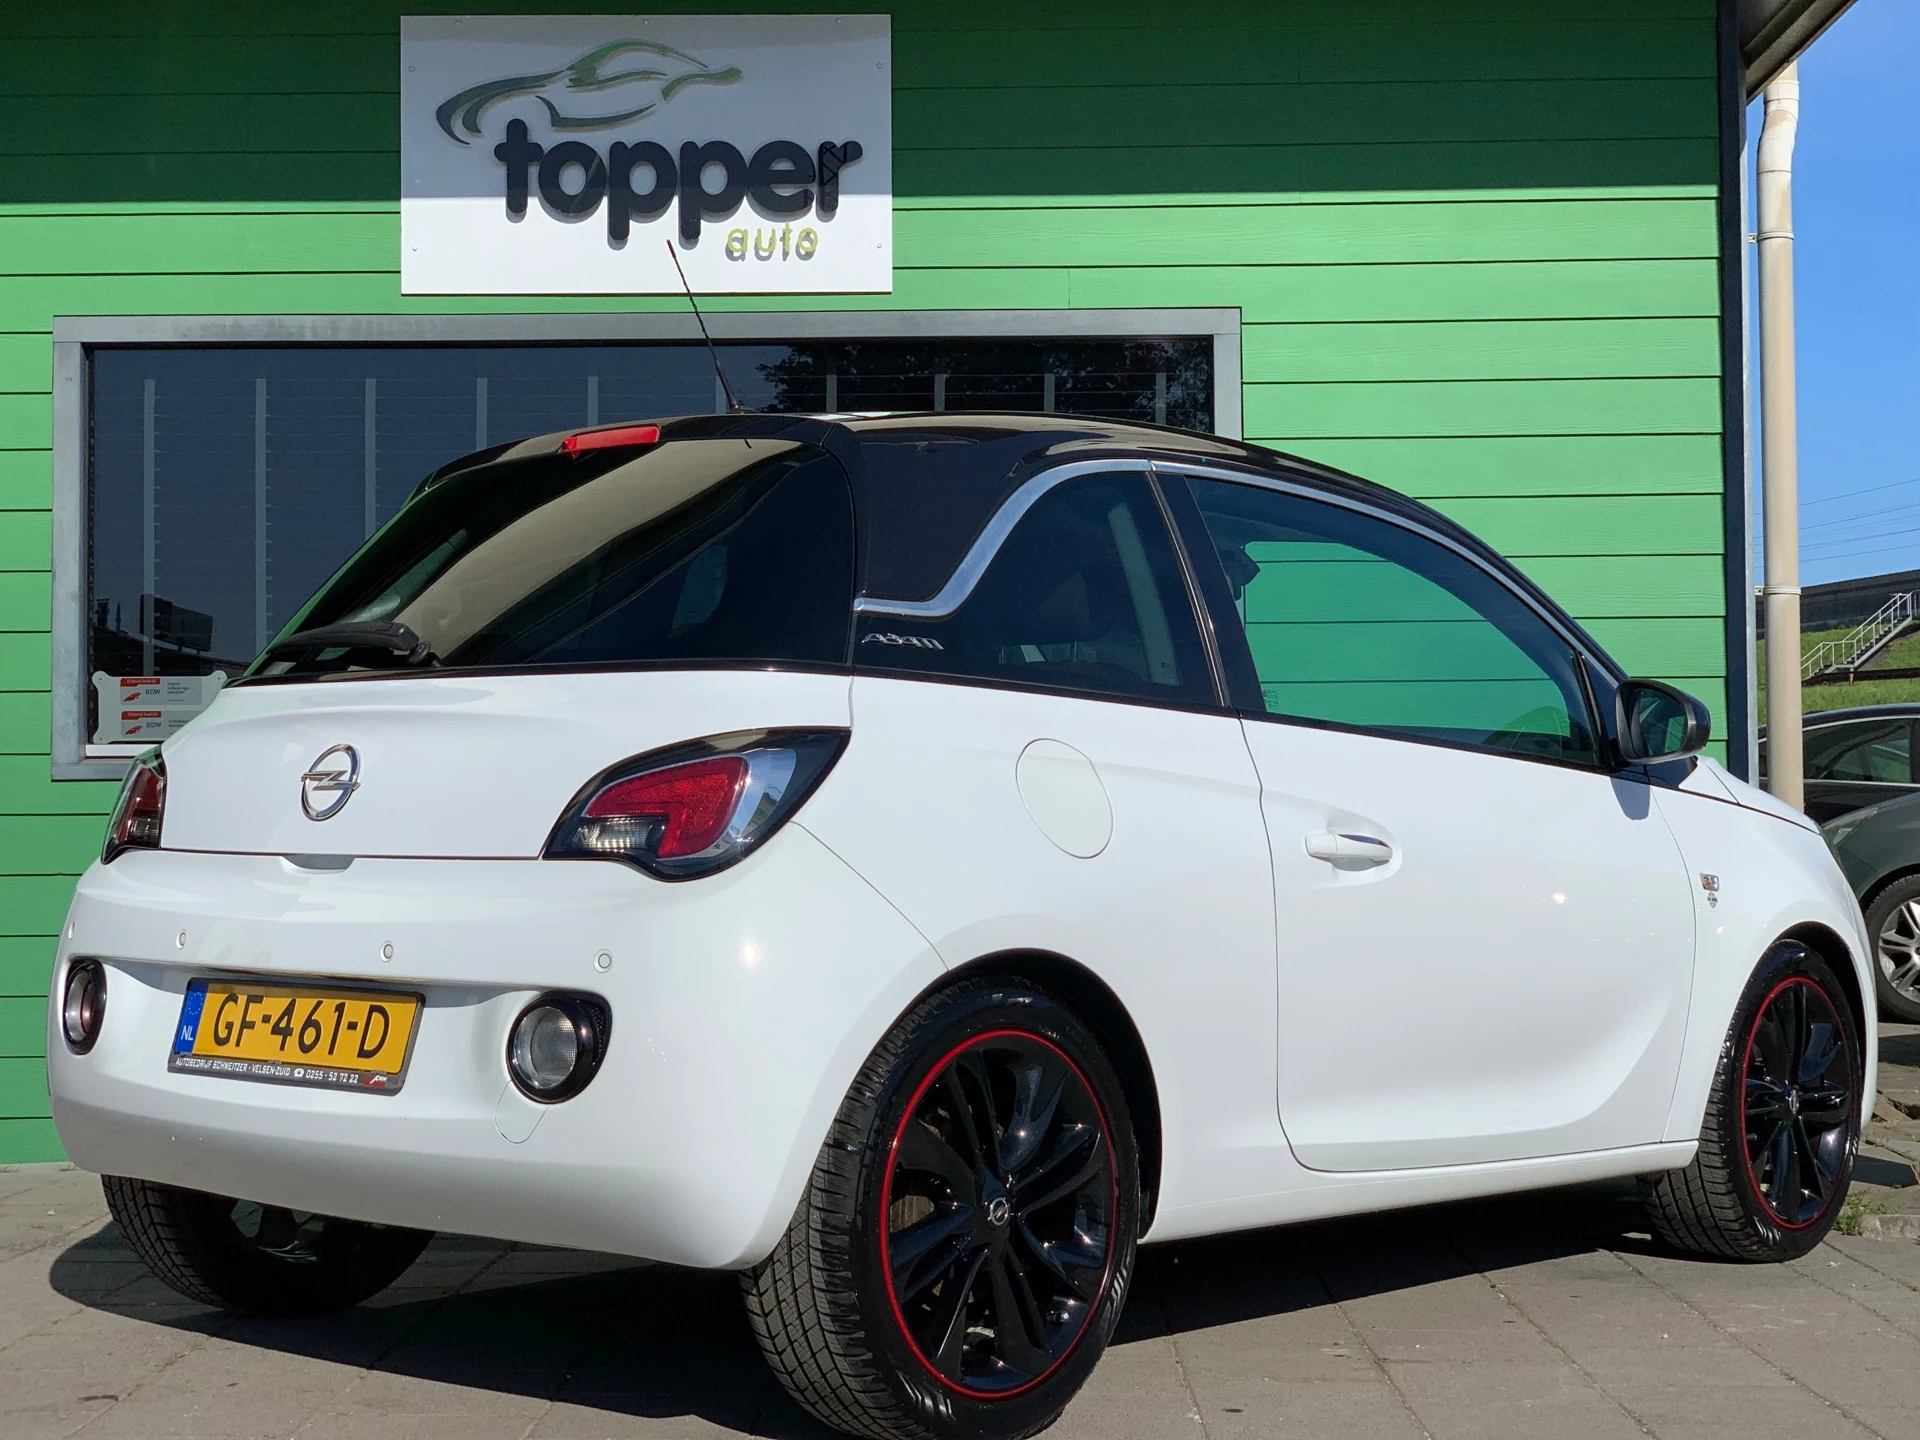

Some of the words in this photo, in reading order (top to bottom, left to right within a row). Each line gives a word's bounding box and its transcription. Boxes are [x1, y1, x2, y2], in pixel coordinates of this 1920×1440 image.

[494, 117, 863, 241] topper
[727, 222, 819, 254] auto
[180, 1024, 194, 1041] NL
[213, 993, 390, 1059] GF-461-D
[175, 1057, 213, 1069] AUTOBEDRIJF
[212, 1060, 248, 1072] SCHWEITZER
[306, 1069, 324, 1080] 0255
